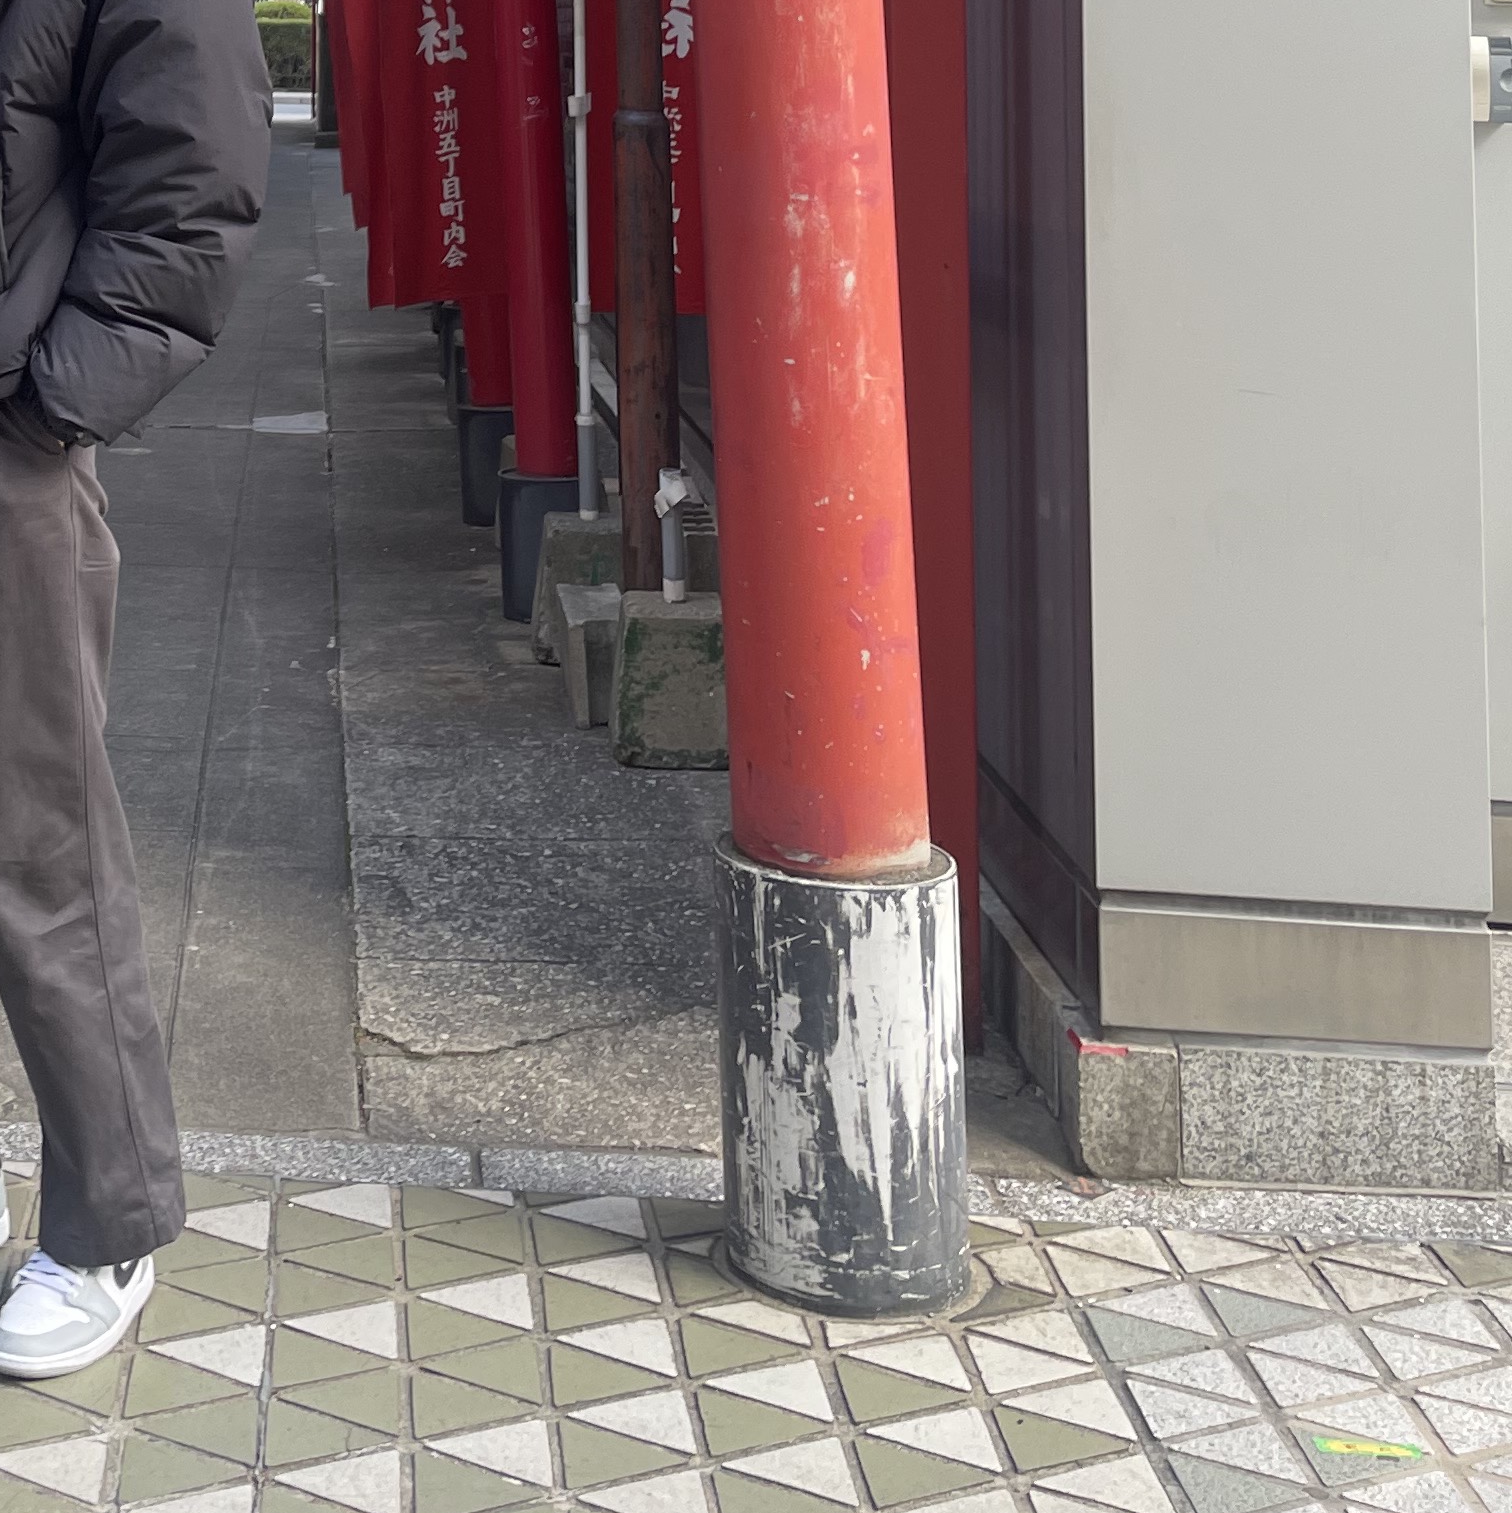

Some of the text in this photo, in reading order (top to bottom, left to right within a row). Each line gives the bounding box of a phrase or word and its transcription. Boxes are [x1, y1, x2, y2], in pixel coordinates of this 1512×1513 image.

[433, 84, 468, 269] 中洲五丁目町内会
